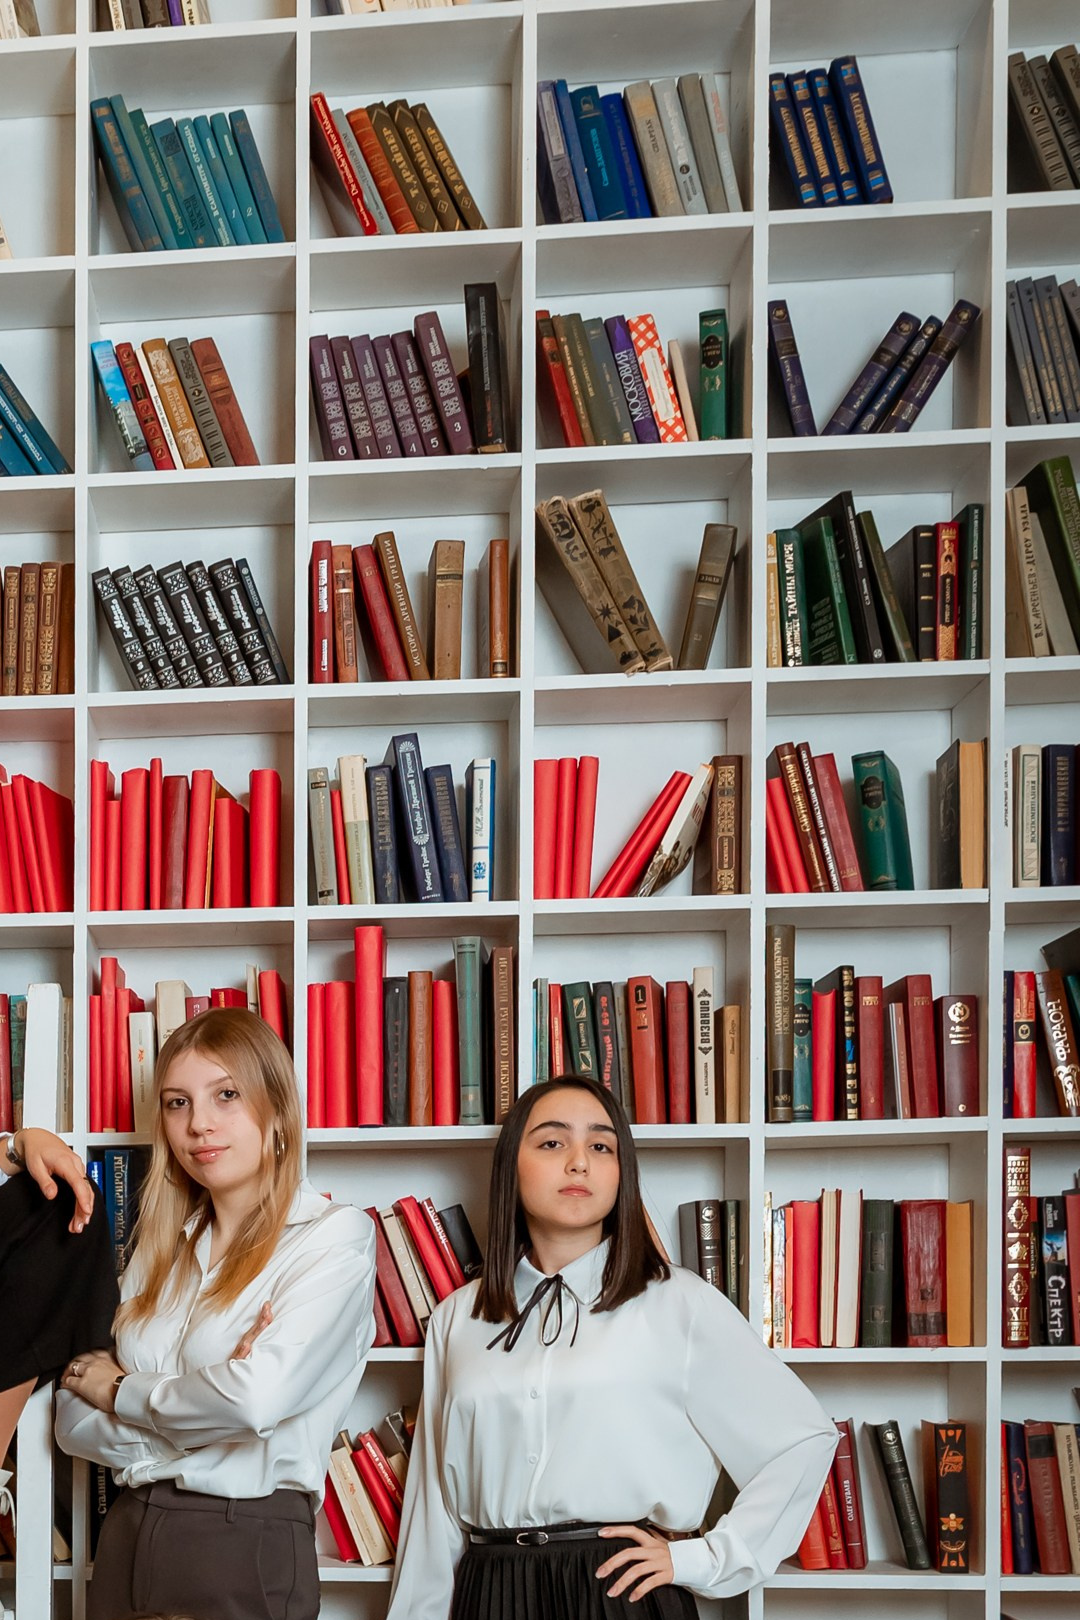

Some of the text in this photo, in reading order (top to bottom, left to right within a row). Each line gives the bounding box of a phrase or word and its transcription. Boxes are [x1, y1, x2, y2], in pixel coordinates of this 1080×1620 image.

[311, 95, 335, 135] Mohammed
[643, 118, 661, 153] СПАРТАК
[180, 123, 200, 154] СЕРДЦА
[330, 143, 344, 159] Welt
[336, 157, 355, 186] iranische
[381, 126, 419, 198] Т.ДРАЙЗЕР
[404, 126, 442, 198] Т.ДРАЙЗЕР
[425, 126, 464, 195] Т.ДРАЙЗЕР
[195, 161, 220, 211] САНТИМЕТРЕ
[614, 349, 646, 423] МОСКОВИЯ
[429, 437, 439, 449] 5
[453, 420, 462, 432] 3
[337, 444, 348, 456] 6
[366, 444, 371, 456] 1
[384, 443, 393, 455] 2
[408, 442, 417, 454] 4
[783, 542, 797, 615] ТАЙНЫ МОРЯ
[1019, 502, 1045, 638] В.К.АРСЕНЬЕВ ДЕРСУ УЗАЛА
[382, 539, 421, 666] ИСТОРИЯ ДРЕВНЕЙ ГРЕЦИИ
[401, 750, 427, 835] Мифы Древней Греции
[784, 761, 813, 833] СМУТНОЕ ВРЕМЯ
[422, 867, 435, 892] Роберт
[635, 986, 646, 1004] 1
[773, 937, 782, 1035] ПАМЯТНИКИ КУЛЬТУРЫ
[782, 956, 790, 1035] НОВЫЕ ОТКРЫТИЯ
[597, 993, 611, 1026] 69-70
[1047, 996, 1071, 1063] ФАРАОН
[498, 956, 510, 1114] ИСТОРИЯ РУССКОГО ИСКУССТВА
[113, 1155, 125, 1239] ЧУДЕС ПРИРОДЫ
[1008, 1306, 1029, 1322] XII
[843, 1479, 854, 1521] ОЛЕГ КУВАЕВ
